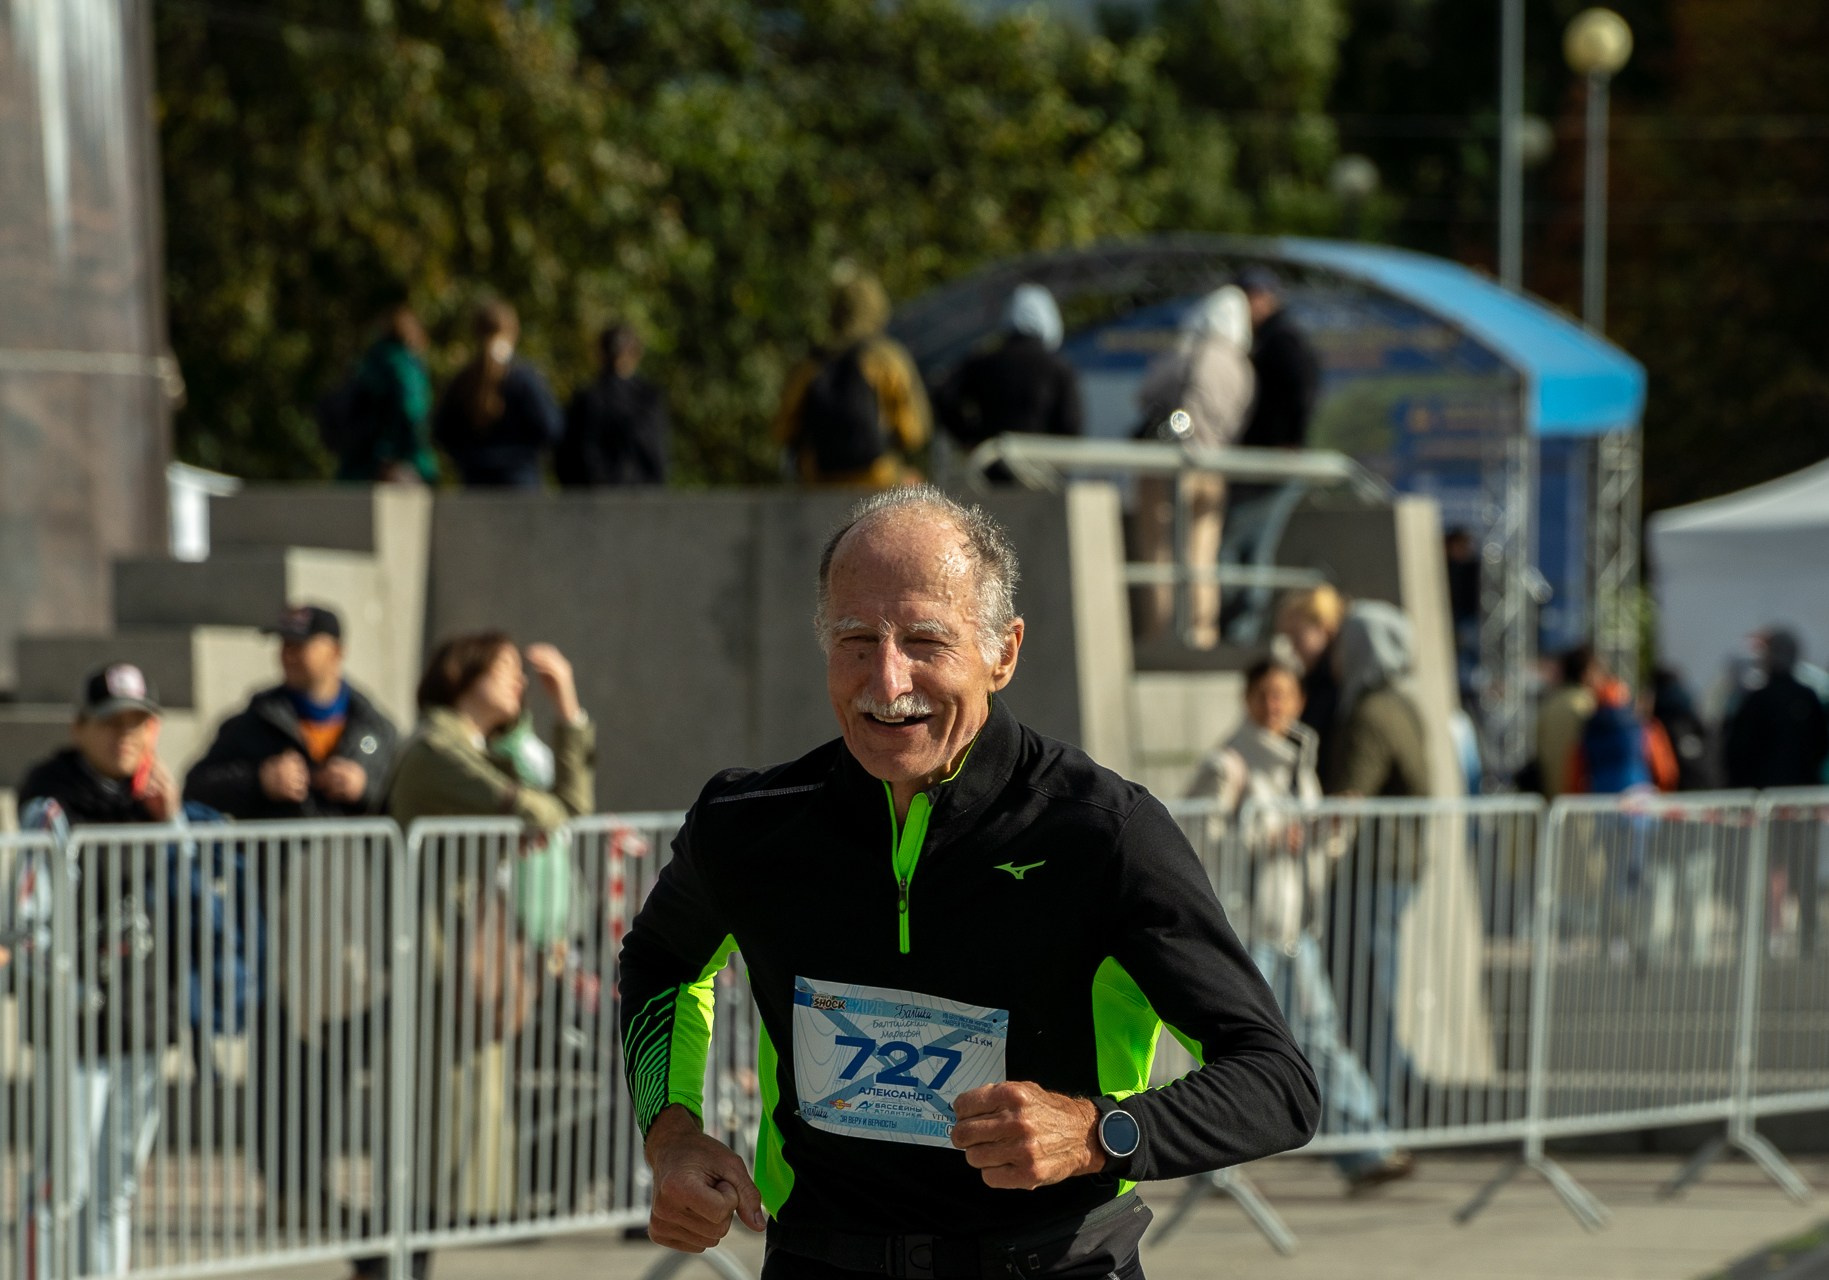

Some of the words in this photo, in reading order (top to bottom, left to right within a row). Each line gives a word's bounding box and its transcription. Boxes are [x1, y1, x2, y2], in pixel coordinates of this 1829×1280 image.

[813, 998, 846, 1010] SHOCK
[835, 1035, 962, 1090] 727
[858, 1086, 933, 1102] АЛЕКСАНДР
[915, 1120, 945, 1137] 2026
